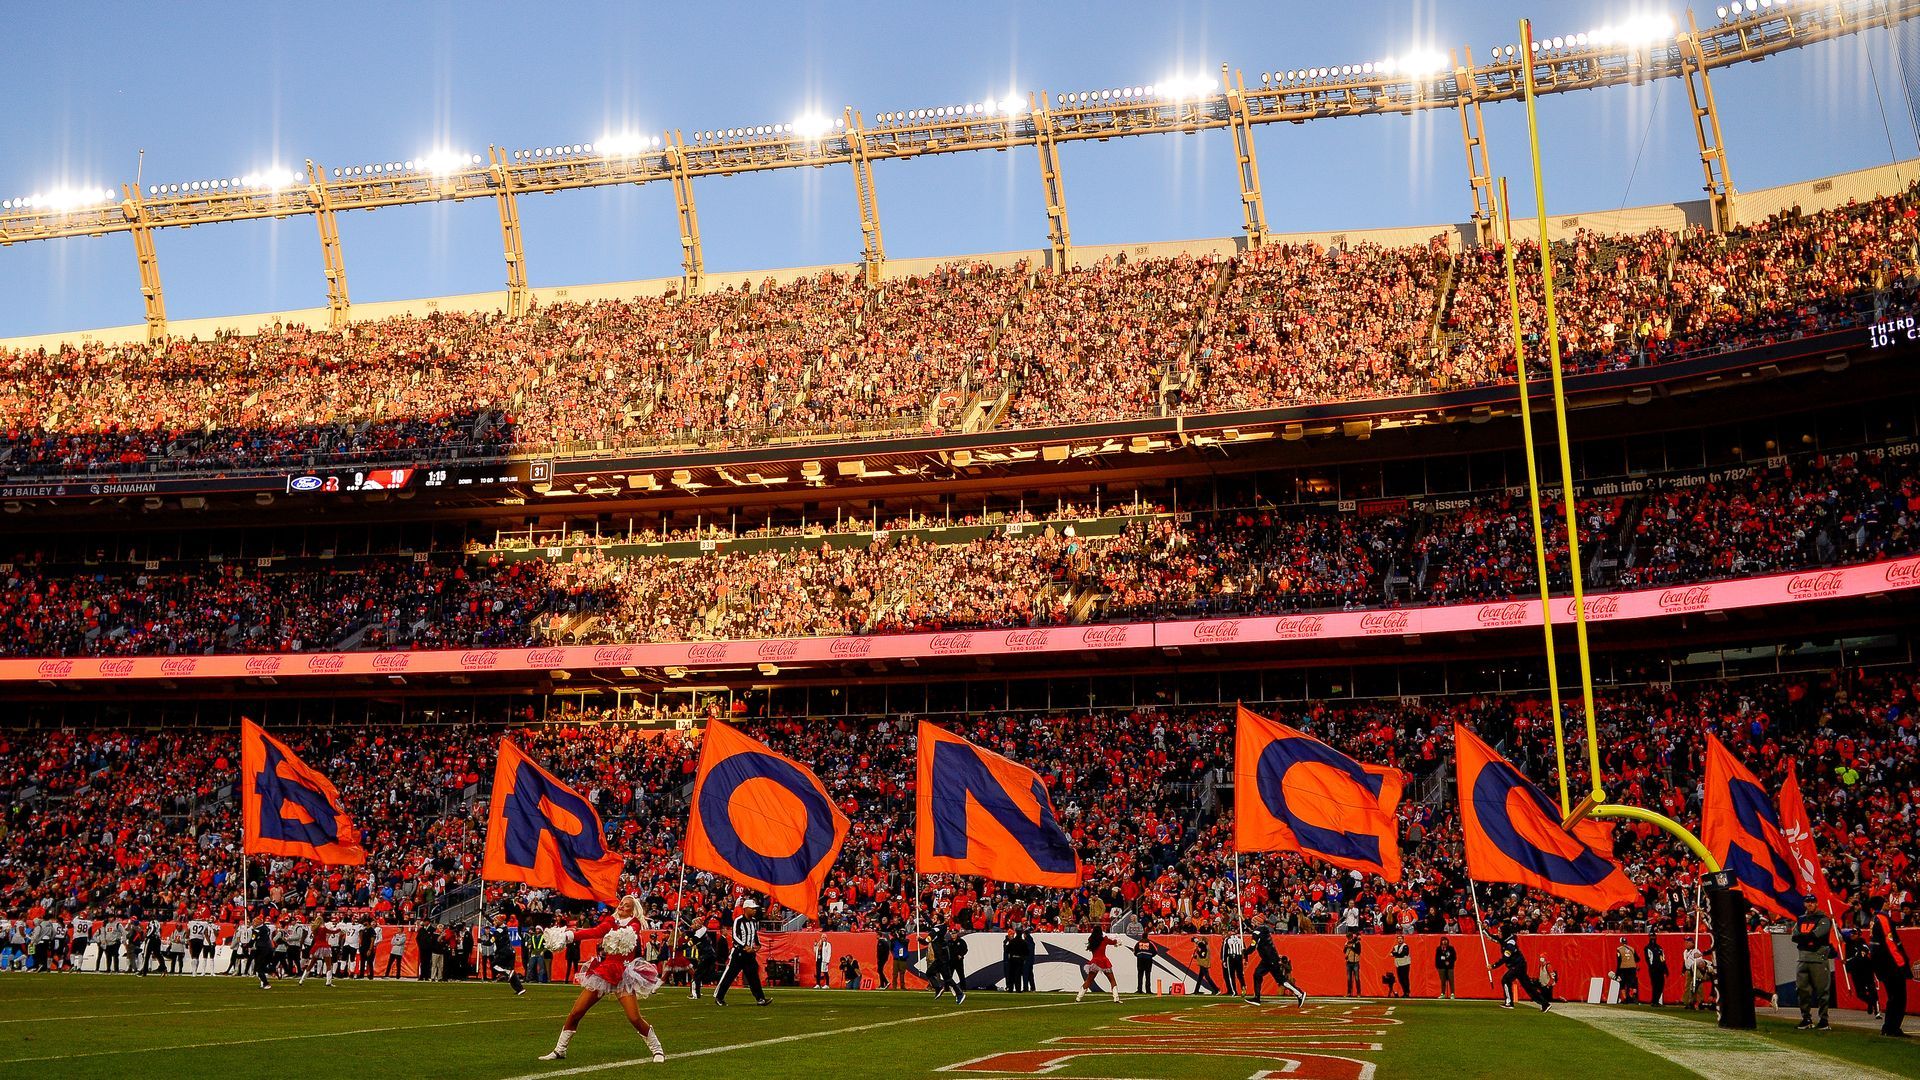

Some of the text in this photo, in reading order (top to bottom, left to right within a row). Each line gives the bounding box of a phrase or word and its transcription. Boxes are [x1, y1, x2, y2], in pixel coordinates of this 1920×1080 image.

[1815, 183, 1831, 192] 540
[1564, 219, 1576, 227] 539
[556, 289, 568, 297] 533
[426, 300, 438, 308] 532
[1868, 317, 1915, 337] THIRD
[390, 470, 404, 483] 10
[428, 470, 446, 481] 1:15
[534, 467, 544, 477] 31
[296, 477, 316, 488] Ford
[354, 472, 364, 486] 9
[1593, 482, 1619, 496] with
[1621, 480, 1643, 493] info
[1658, 474, 1705, 489] lcation
[1709, 472, 1721, 484] to
[3, 488, 13, 496] 24
[16, 487, 52, 496] BAILEY
[103, 483, 156, 494] SHANAHAN
[1339, 502, 1354, 510] 342
[1176, 513, 1190, 521] 341
[1007, 524, 1021, 532] 340
[548, 548, 561, 556] 337
[146, 561, 159, 569] 334
[1787, 571, 1845, 594] Coca-Cola
[1659, 585, 1712, 607] Coca-Cola
[1478, 603, 1528, 621] Coca-Cola
[1275, 616, 1324, 633] Coca-Cola
[1360, 612, 1409, 629] Coca-Cola
[1082, 626, 1128, 642] Coca-Cola
[1194, 620, 1241, 637] Coca-Cola
[929, 633, 973, 649] Coca-Cola
[1005, 630, 1048, 646] Coca-Cola
[687, 644, 728, 659] Coca-Cola
[758, 641, 799, 656] Coca-Cola
[830, 638, 873, 653] Coca-Cola
[372, 654, 411, 667] Coca-Cola
[461, 651, 500, 665] Coca-Cola
[526, 649, 566, 663] Coca-Cola
[594, 647, 635, 661] Coca-Cola
[37, 661, 74, 674] Coca-Cola
[99, 660, 136, 673] Coca-Cola
[160, 658, 198, 672] Coca-Cola
[245, 657, 284, 670] Coca-Cola
[308, 655, 346, 668] Coca-Cola
[256, 734, 340, 847] B
[931, 740, 1077, 874] N
[1256, 737, 1384, 868] C
[503, 758, 606, 888] R
[699, 751, 834, 886] O
[736, 886, 744, 894] 80
[1673, 893, 1679, 902] 9
[1161, 900, 1171, 909] 58
[56, 926, 66, 936] 55
[77, 923, 88, 934] 98
[192, 924, 205, 935] 92
[863, 979, 872, 988] 10
[1173, 984, 1182, 993] G
